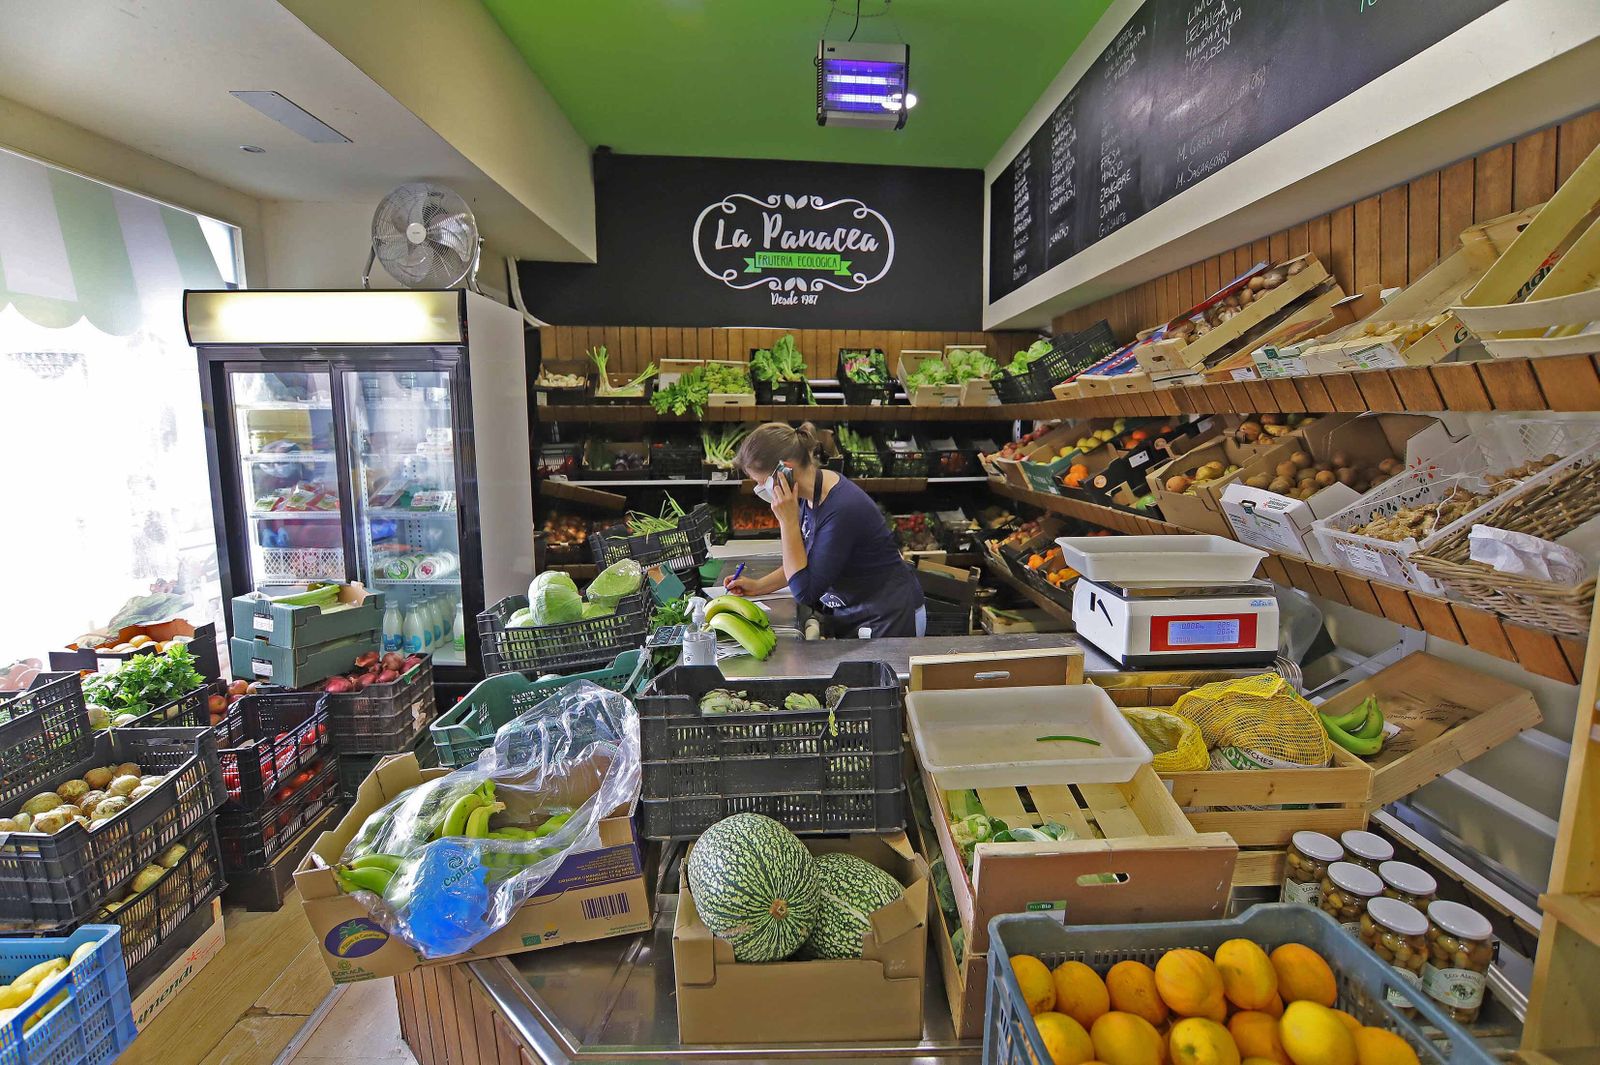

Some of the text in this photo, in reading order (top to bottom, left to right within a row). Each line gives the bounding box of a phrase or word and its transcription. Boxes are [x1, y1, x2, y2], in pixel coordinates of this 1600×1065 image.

[715, 211, 879, 252] La Panacea
[758, 254, 838, 268] FRUTERIA ECOLOGICA
[770, 290, 819, 306] Desde 1987
